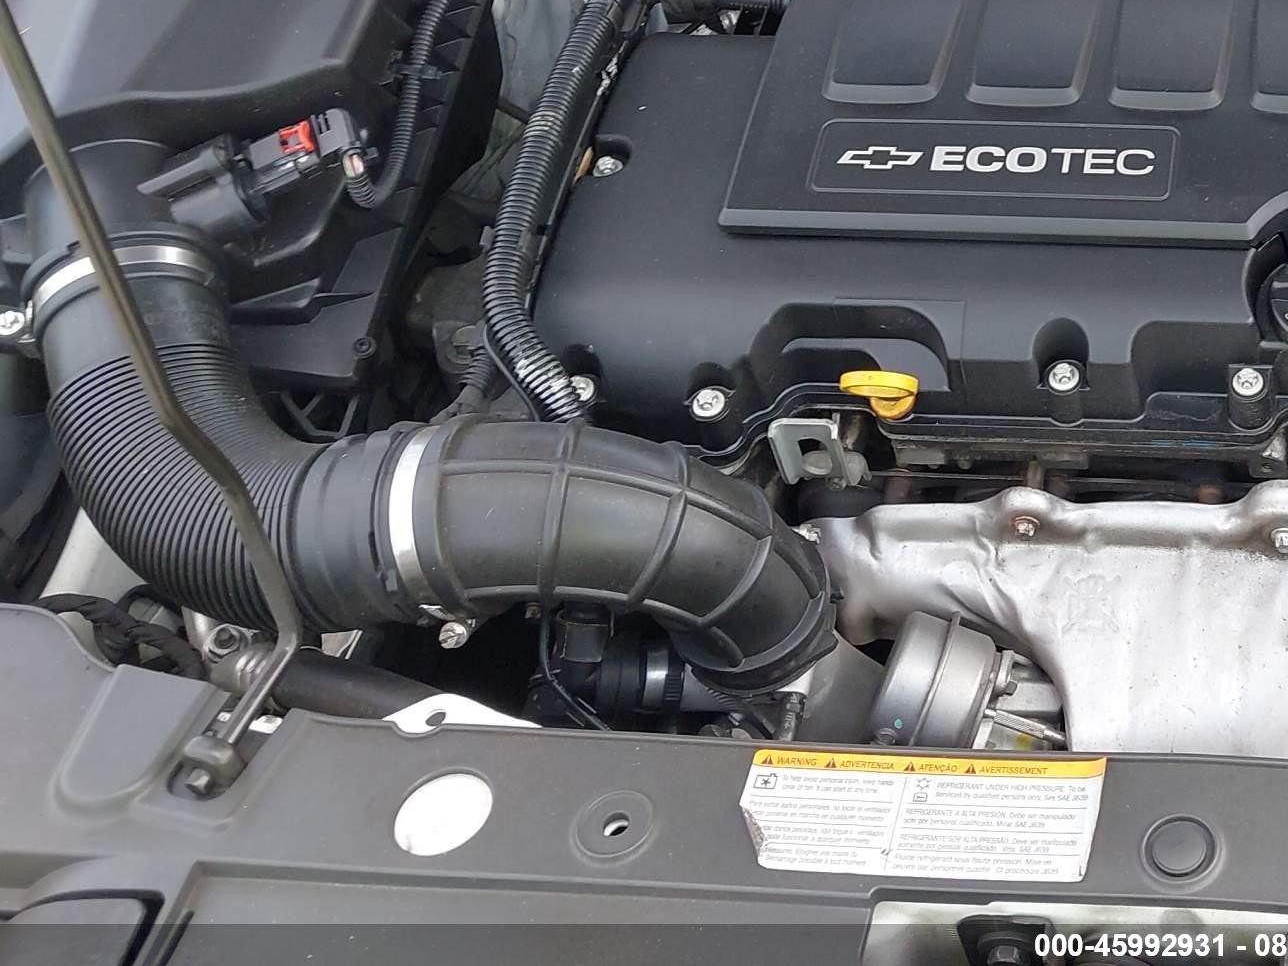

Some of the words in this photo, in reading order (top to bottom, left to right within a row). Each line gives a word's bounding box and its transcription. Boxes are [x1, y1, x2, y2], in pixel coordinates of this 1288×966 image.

[930, 145, 1155, 176] ECOTEC
[776, 756, 818, 767] WARNING
[979, 765, 1048, 775] AVERTISSEMENT
